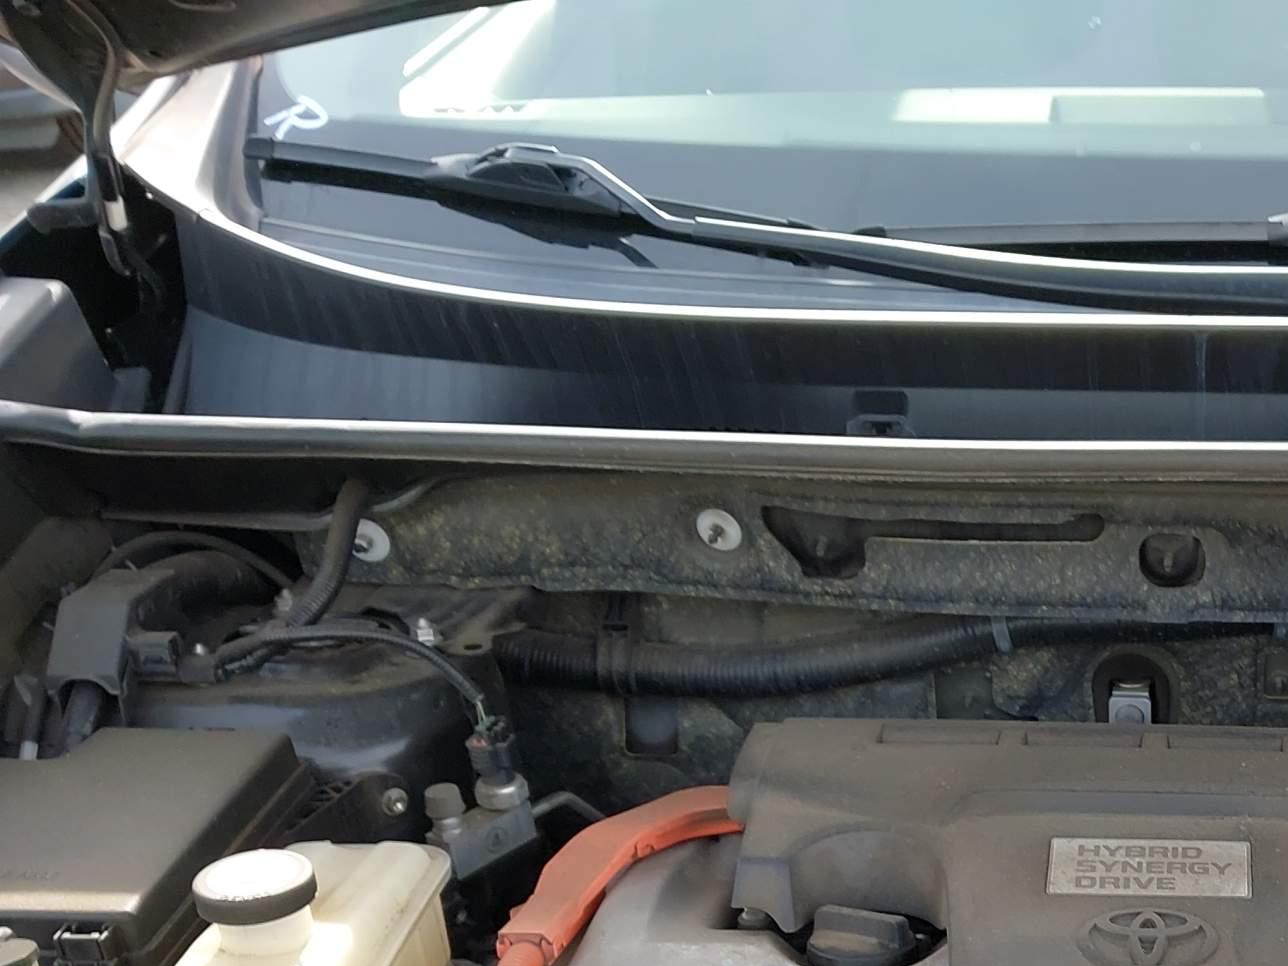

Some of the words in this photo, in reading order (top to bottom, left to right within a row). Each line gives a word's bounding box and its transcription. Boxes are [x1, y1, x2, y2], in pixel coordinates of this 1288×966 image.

[1077, 844, 1203, 859] HYBRID
[1075, 860, 1233, 875] SYNERGY
[1074, 876, 1177, 890] DRIVE
